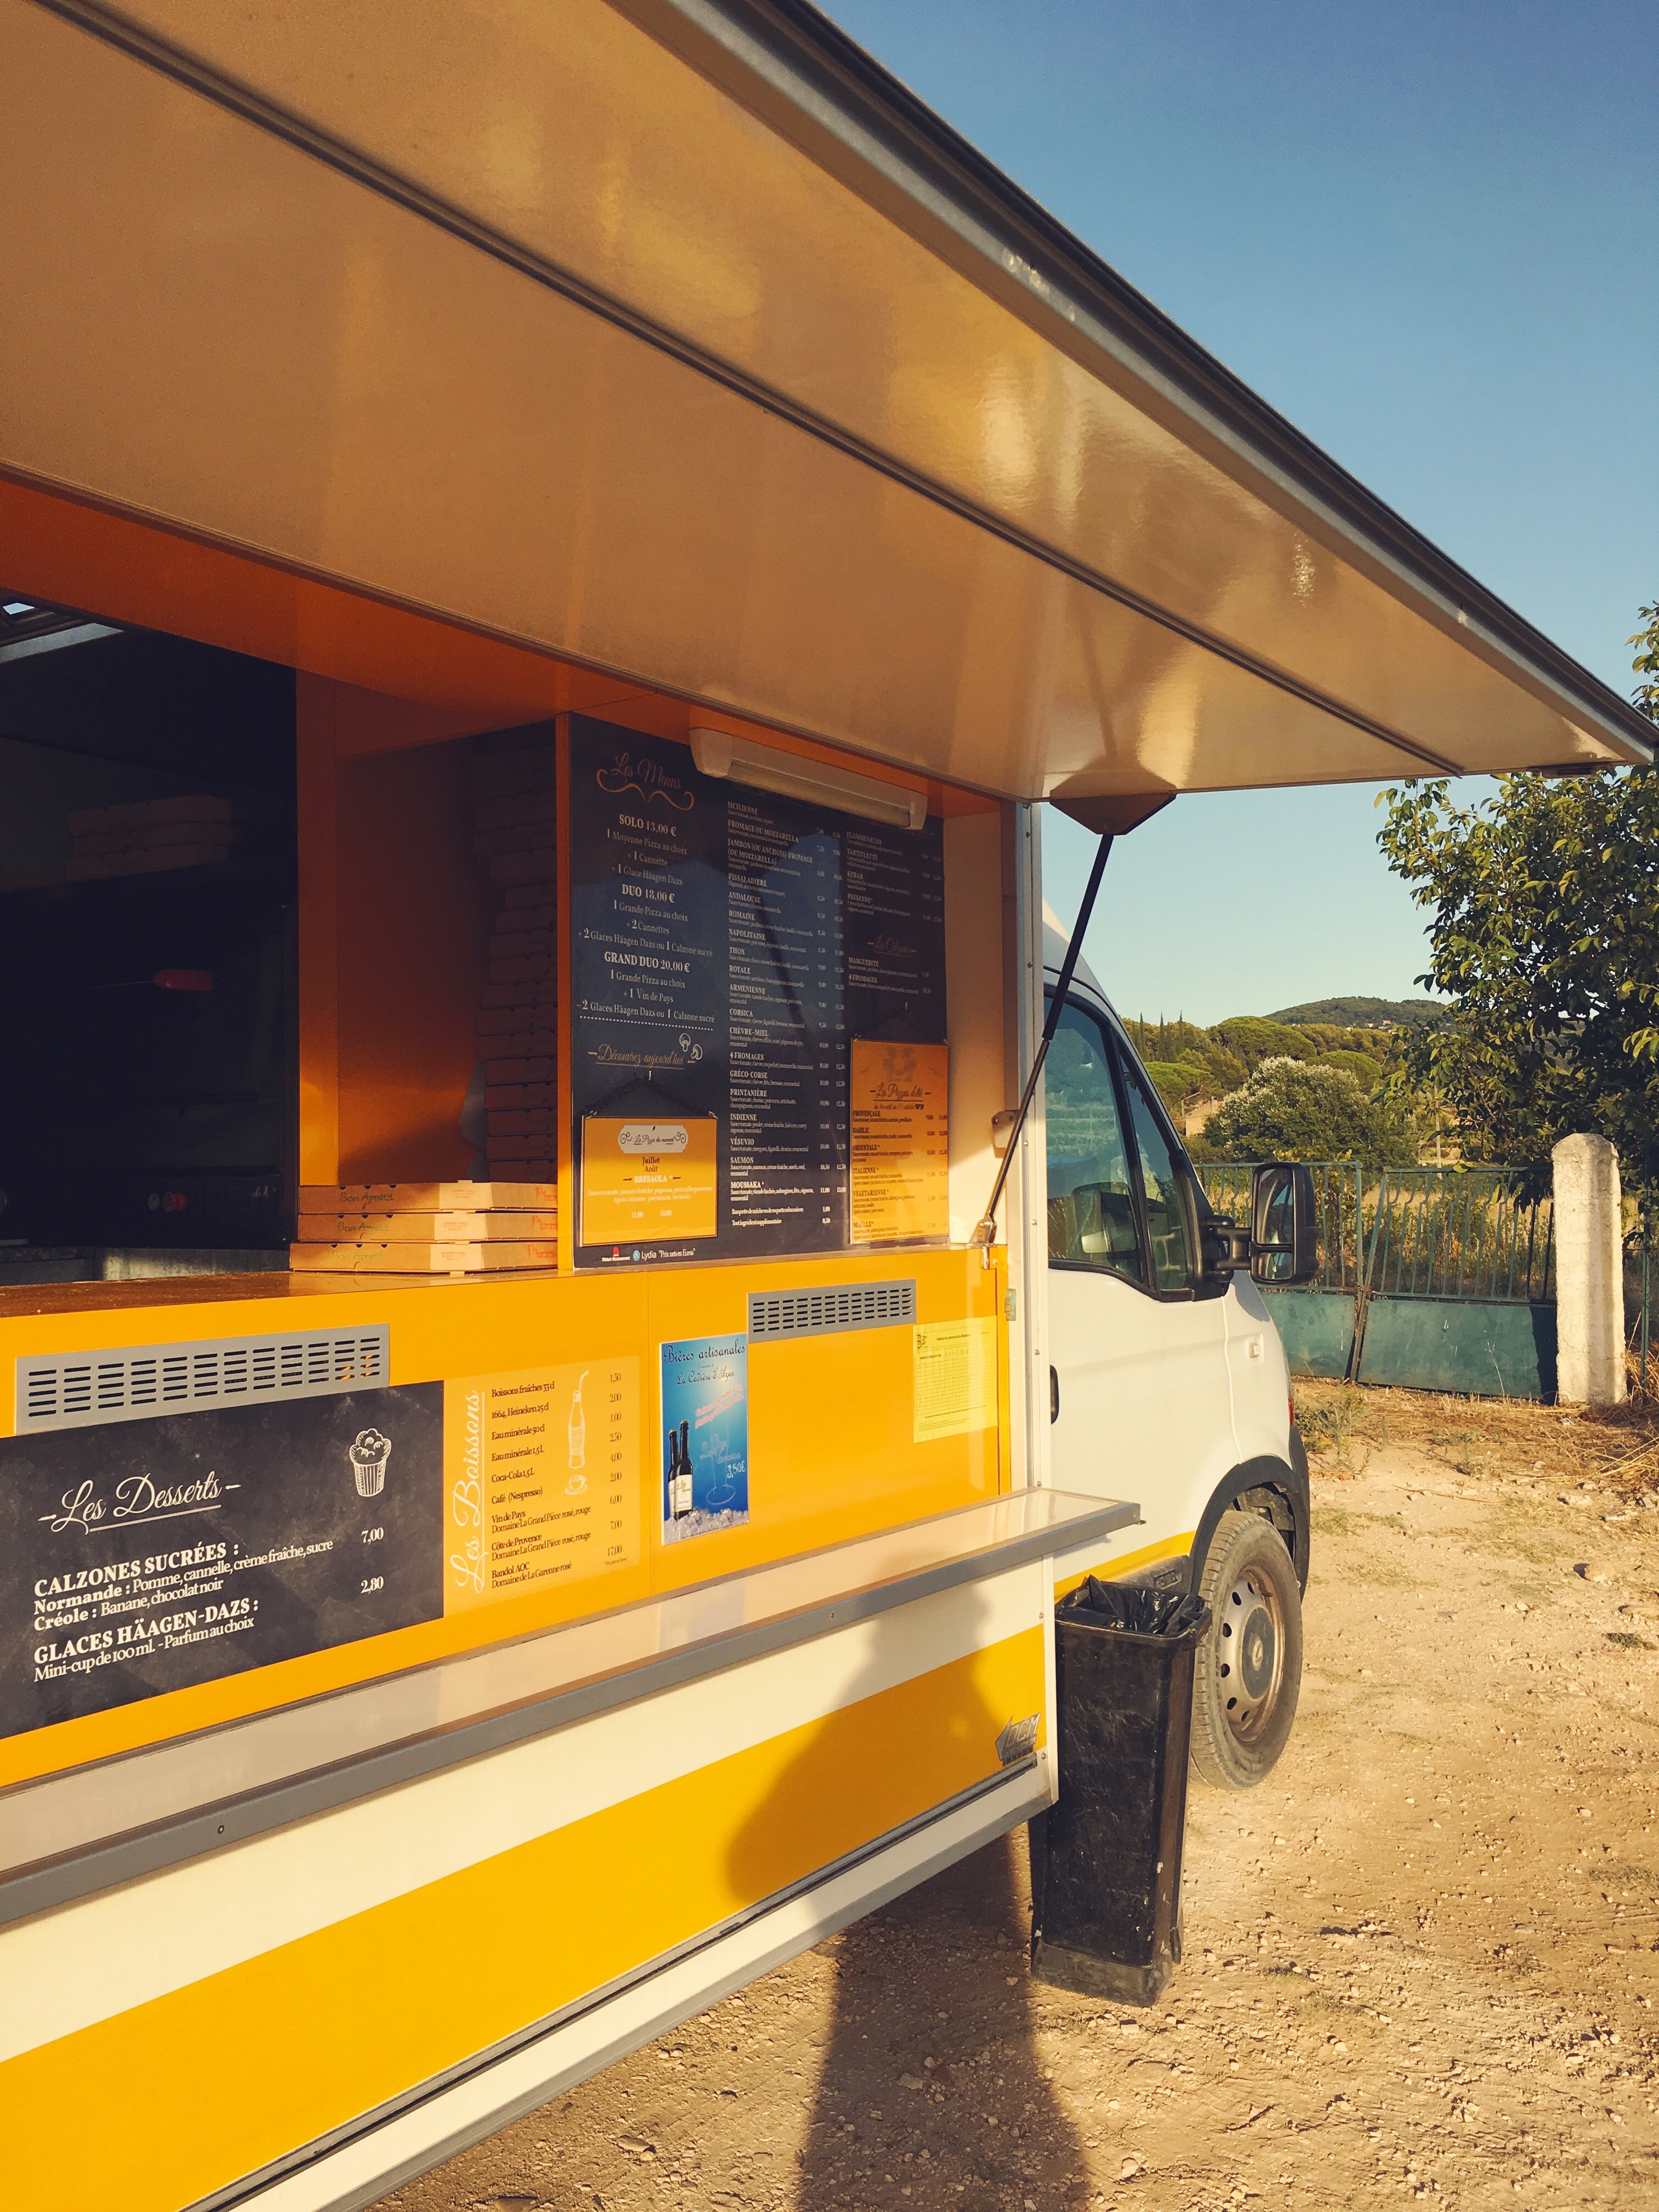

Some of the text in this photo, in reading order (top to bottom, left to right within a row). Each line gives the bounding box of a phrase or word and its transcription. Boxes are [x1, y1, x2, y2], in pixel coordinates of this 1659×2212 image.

[611, 753, 681, 789] Les Menus
[728, 802, 758, 815] SICILIENNE
[619, 814, 644, 828] SOLO
[670, 827, 676, 837] €
[728, 820, 755, 832] FROMAGE
[764, 829, 798, 843] MOZZARELLA
[607, 828, 610, 838] 1
[613, 831, 642, 844] Moyenne
[644, 838, 661, 849] Pizza
[671, 843, 687, 855] choix
[634, 851, 668, 866] 1 Cannette
[728, 838, 813, 864] JAMBON (OU ANCHOIS) FROMAGE
[729, 848, 777, 866] (OU MOZZARELLA)
[618, 865, 683, 885] 1 Glace Häagen Dazs
[622, 884, 642, 897] DUO
[669, 894, 675, 903] €
[729, 891, 761, 904] ANDALOUSE
[729, 910, 755, 921] ROMAINE
[632, 919, 669, 934] 2 Cannettes
[729, 928, 766, 940] NAPOLITAINE
[729, 947, 745, 955] THON
[605, 952, 637, 966] GRAND
[639, 956, 658, 968] DUO
[684, 963, 690, 972] €
[729, 965, 751, 974] ROYALE
[852, 974, 877, 984] FROMAGES
[730, 1008, 753, 1018] CORSICA
[598, 1044, 640, 1066] Découvrez
[734, 1052, 764, 1060] FROMAGES
[642, 1157, 660, 1166] Juillet
[634, 1175, 667, 1183] BRESAOLA
[642, 1251, 657, 1261] Lydia
[664, 1339, 745, 1363] Bières artisanales
[676, 1372, 686, 1385] La
[688, 1370, 710, 1383] Cadière
[492, 1381, 555, 1398] Boissons fraîches 33 cl
[507, 1406, 537, 1416] Heineken
[544, 1402, 549, 1411] cl
[492, 1424, 545, 1441] Eau minérale 50 cl
[492, 1471, 522, 1483] Coca-Cola
[530, 1468, 535, 1476] L
[450, 1390, 488, 1594] Les Boissons
[492, 1487, 543, 1504] Café (Nespresso)
[51, 1470, 223, 1536] Les Desserts
[492, 1522, 520, 1534] Domaine
[520, 1518, 527, 1527] La
[528, 1514, 546, 1525] Grand
[575, 1506, 591, 1517] rouge
[362, 1527, 384, 1545] 7,00
[34, 1542, 227, 1597] CALZONES SUCRÉES
[34, 1539, 334, 1615] Normande Pomme, cannelle, crème fraîche, sucre
[492, 1562, 529, 1579] Bandol AOC
[492, 1560, 572, 1589] Domaine de La Garenne rosé
[361, 1576, 384, 1594] 2,80
[34, 1577, 224, 1632] Créole Banane, chocolat noir
[33, 1657, 95, 1683] Mini-cup
[95, 1651, 111, 1665] de
[136, 1639, 155, 1657] ml.
[165, 1626, 208, 1650] Parfum
[208, 1624, 225, 1638] au
[225, 1615, 254, 1633] choix
[34, 1630, 113, 1664] GLACES
